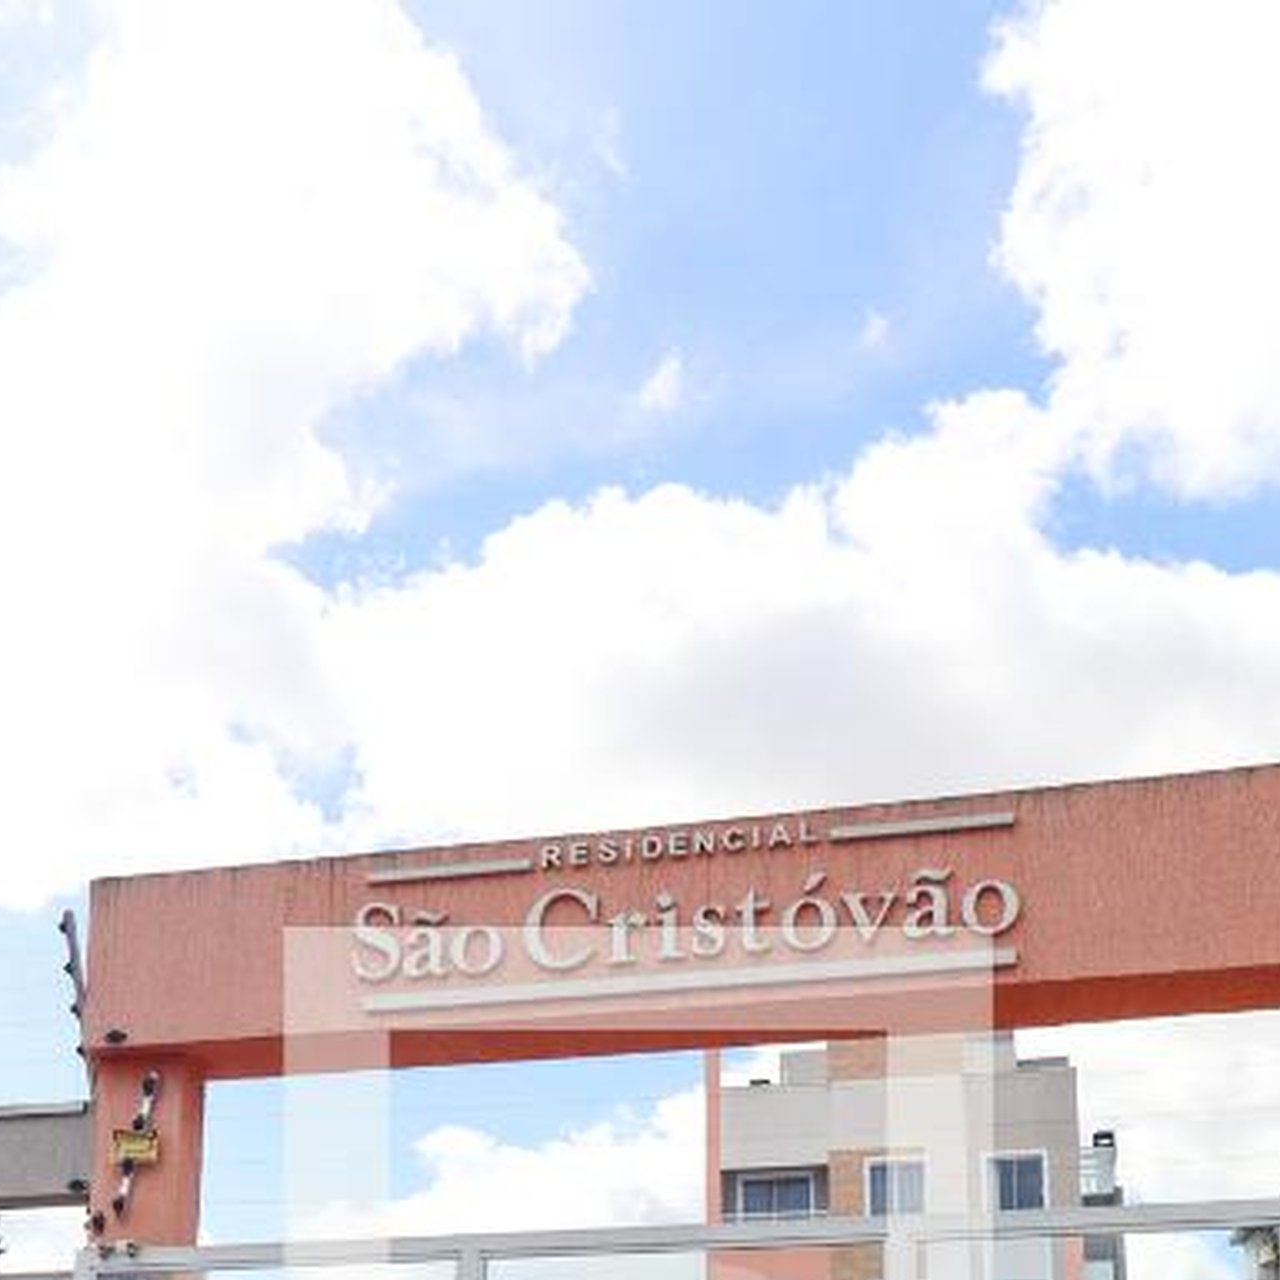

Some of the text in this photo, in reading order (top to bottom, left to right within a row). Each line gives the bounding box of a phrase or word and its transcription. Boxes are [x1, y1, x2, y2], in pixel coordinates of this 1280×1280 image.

[541, 821, 822, 870] RESIDENCIAL
[352, 866, 1020, 983] São Cristóvão
